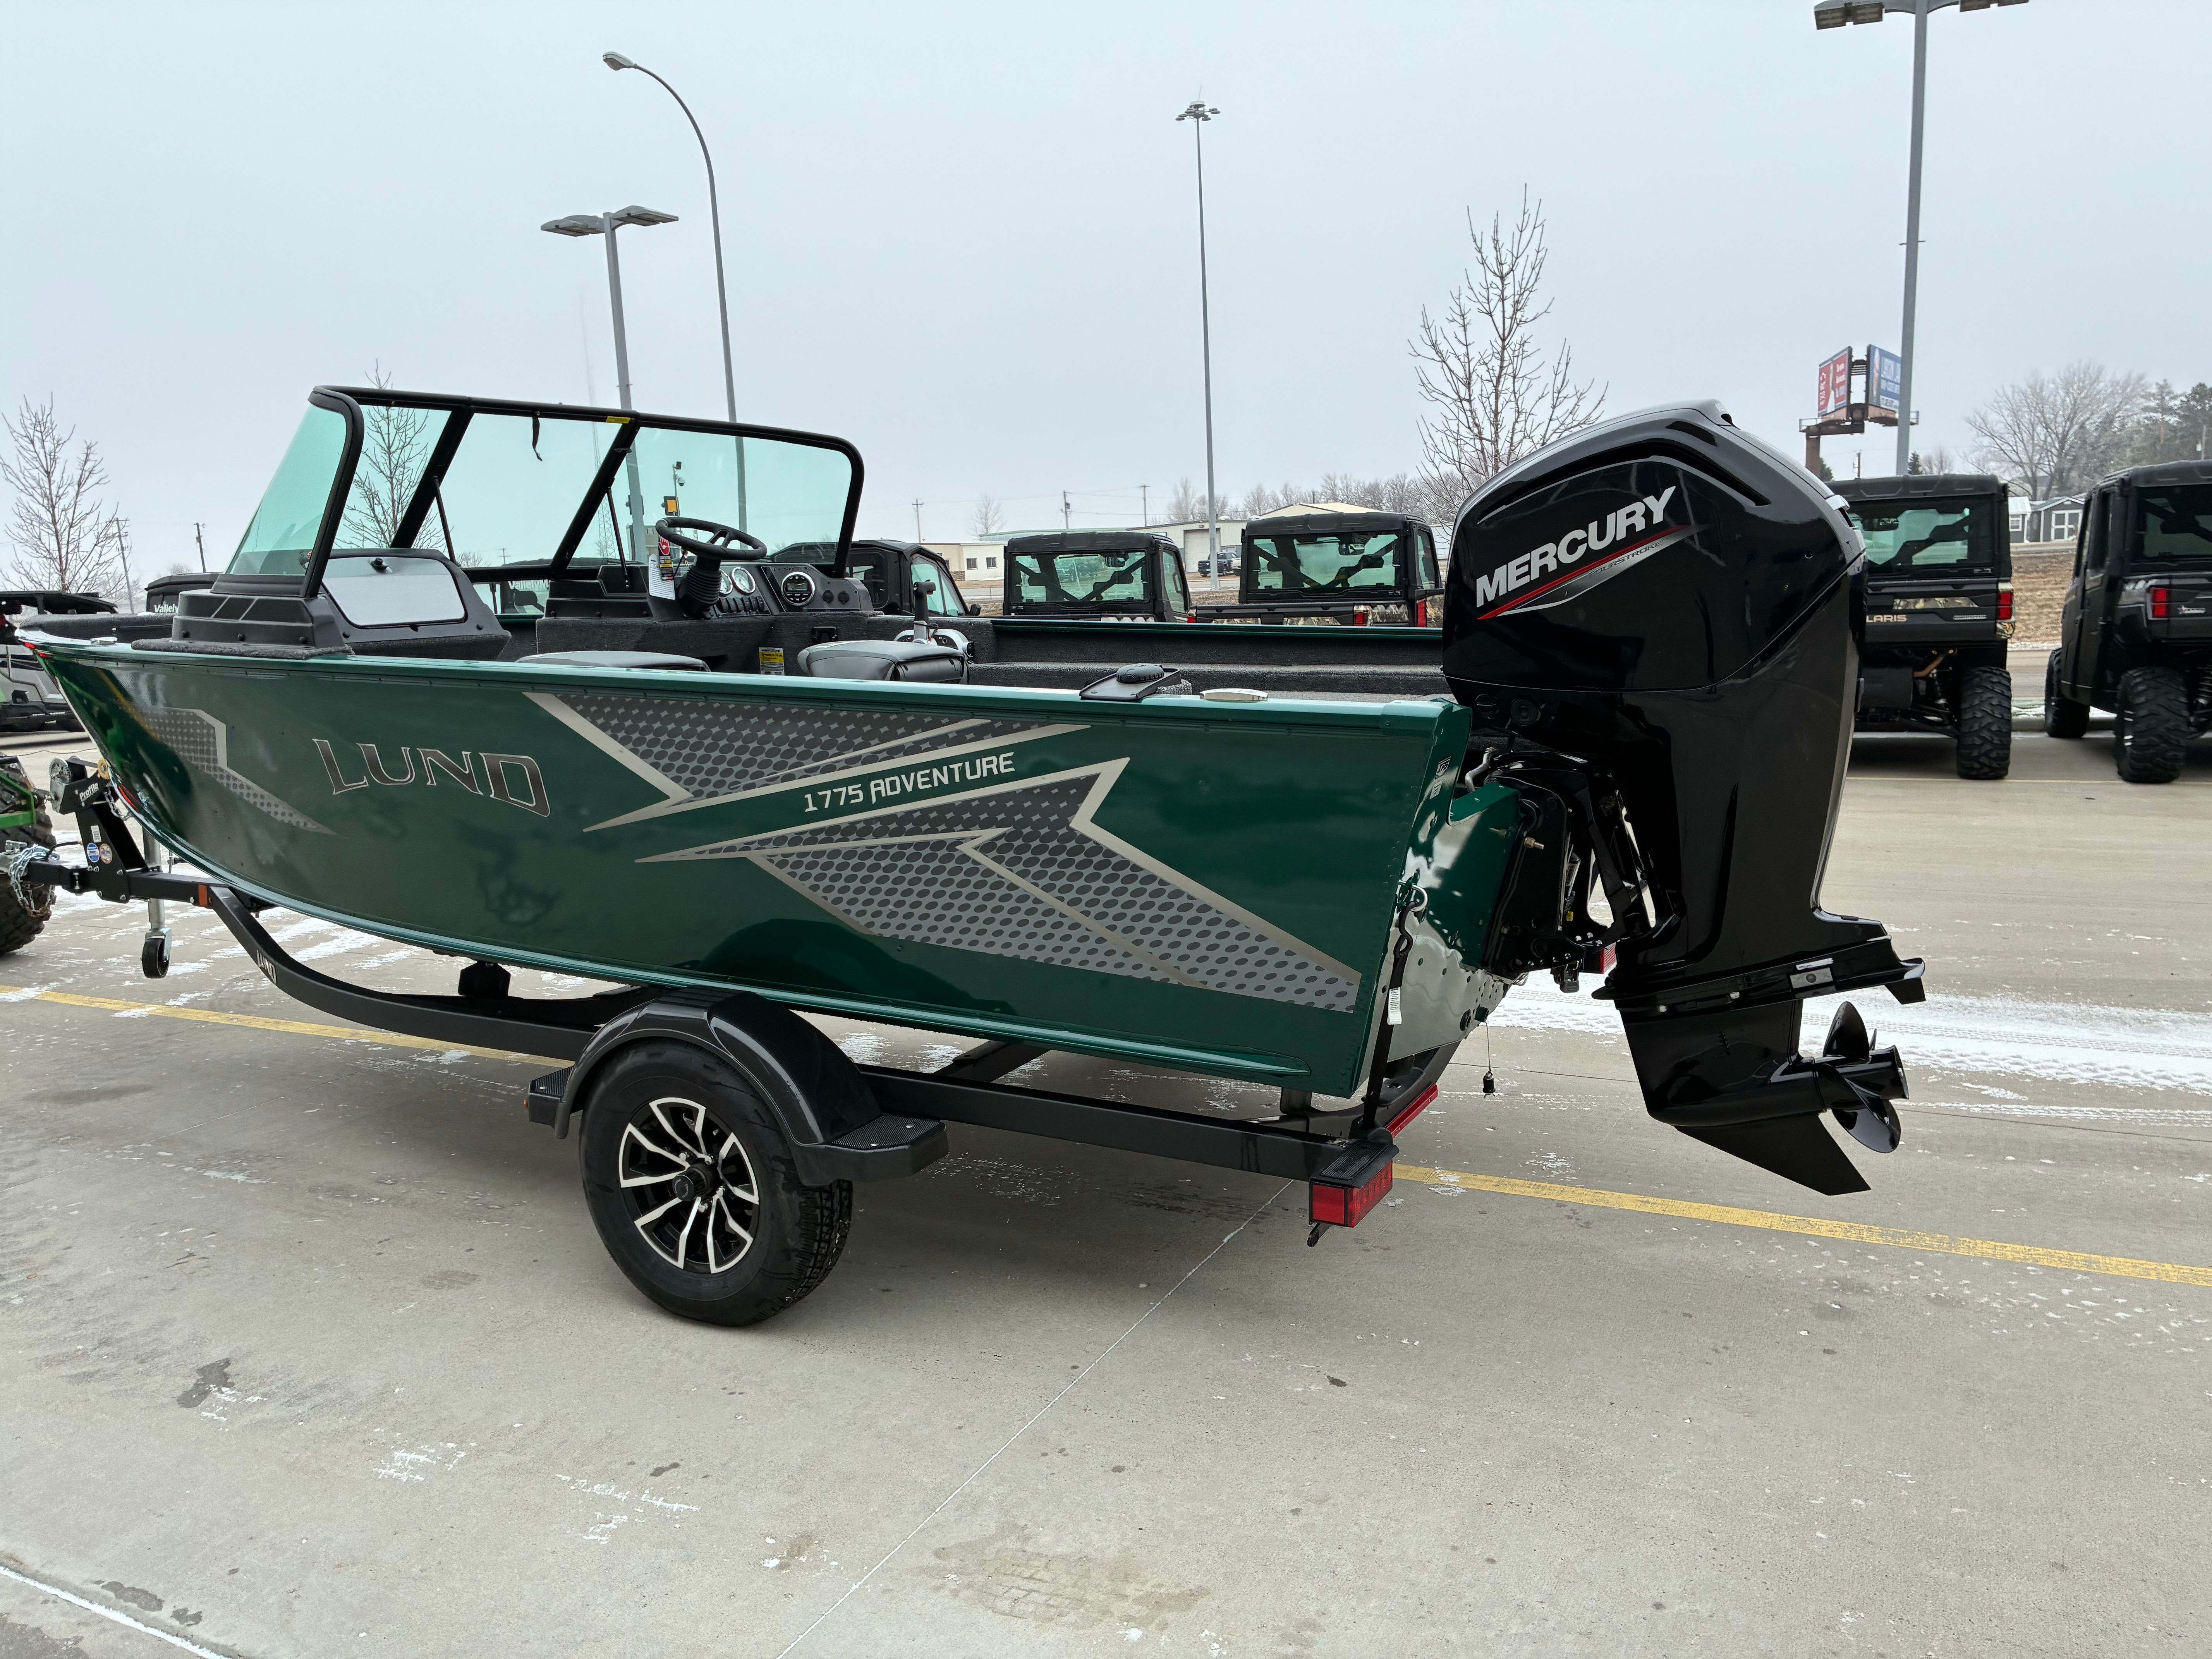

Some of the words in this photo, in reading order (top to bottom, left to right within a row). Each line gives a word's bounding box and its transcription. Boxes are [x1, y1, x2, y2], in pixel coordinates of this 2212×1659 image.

[1477, 486, 1676, 608] MERCURY
[1866, 614, 1907, 623] LARIS
[79, 783, 99, 802] Profile
[311, 738, 551, 817] LUND
[804, 783, 864, 812] 1775
[870, 751, 1016, 805] ADVENTURE
